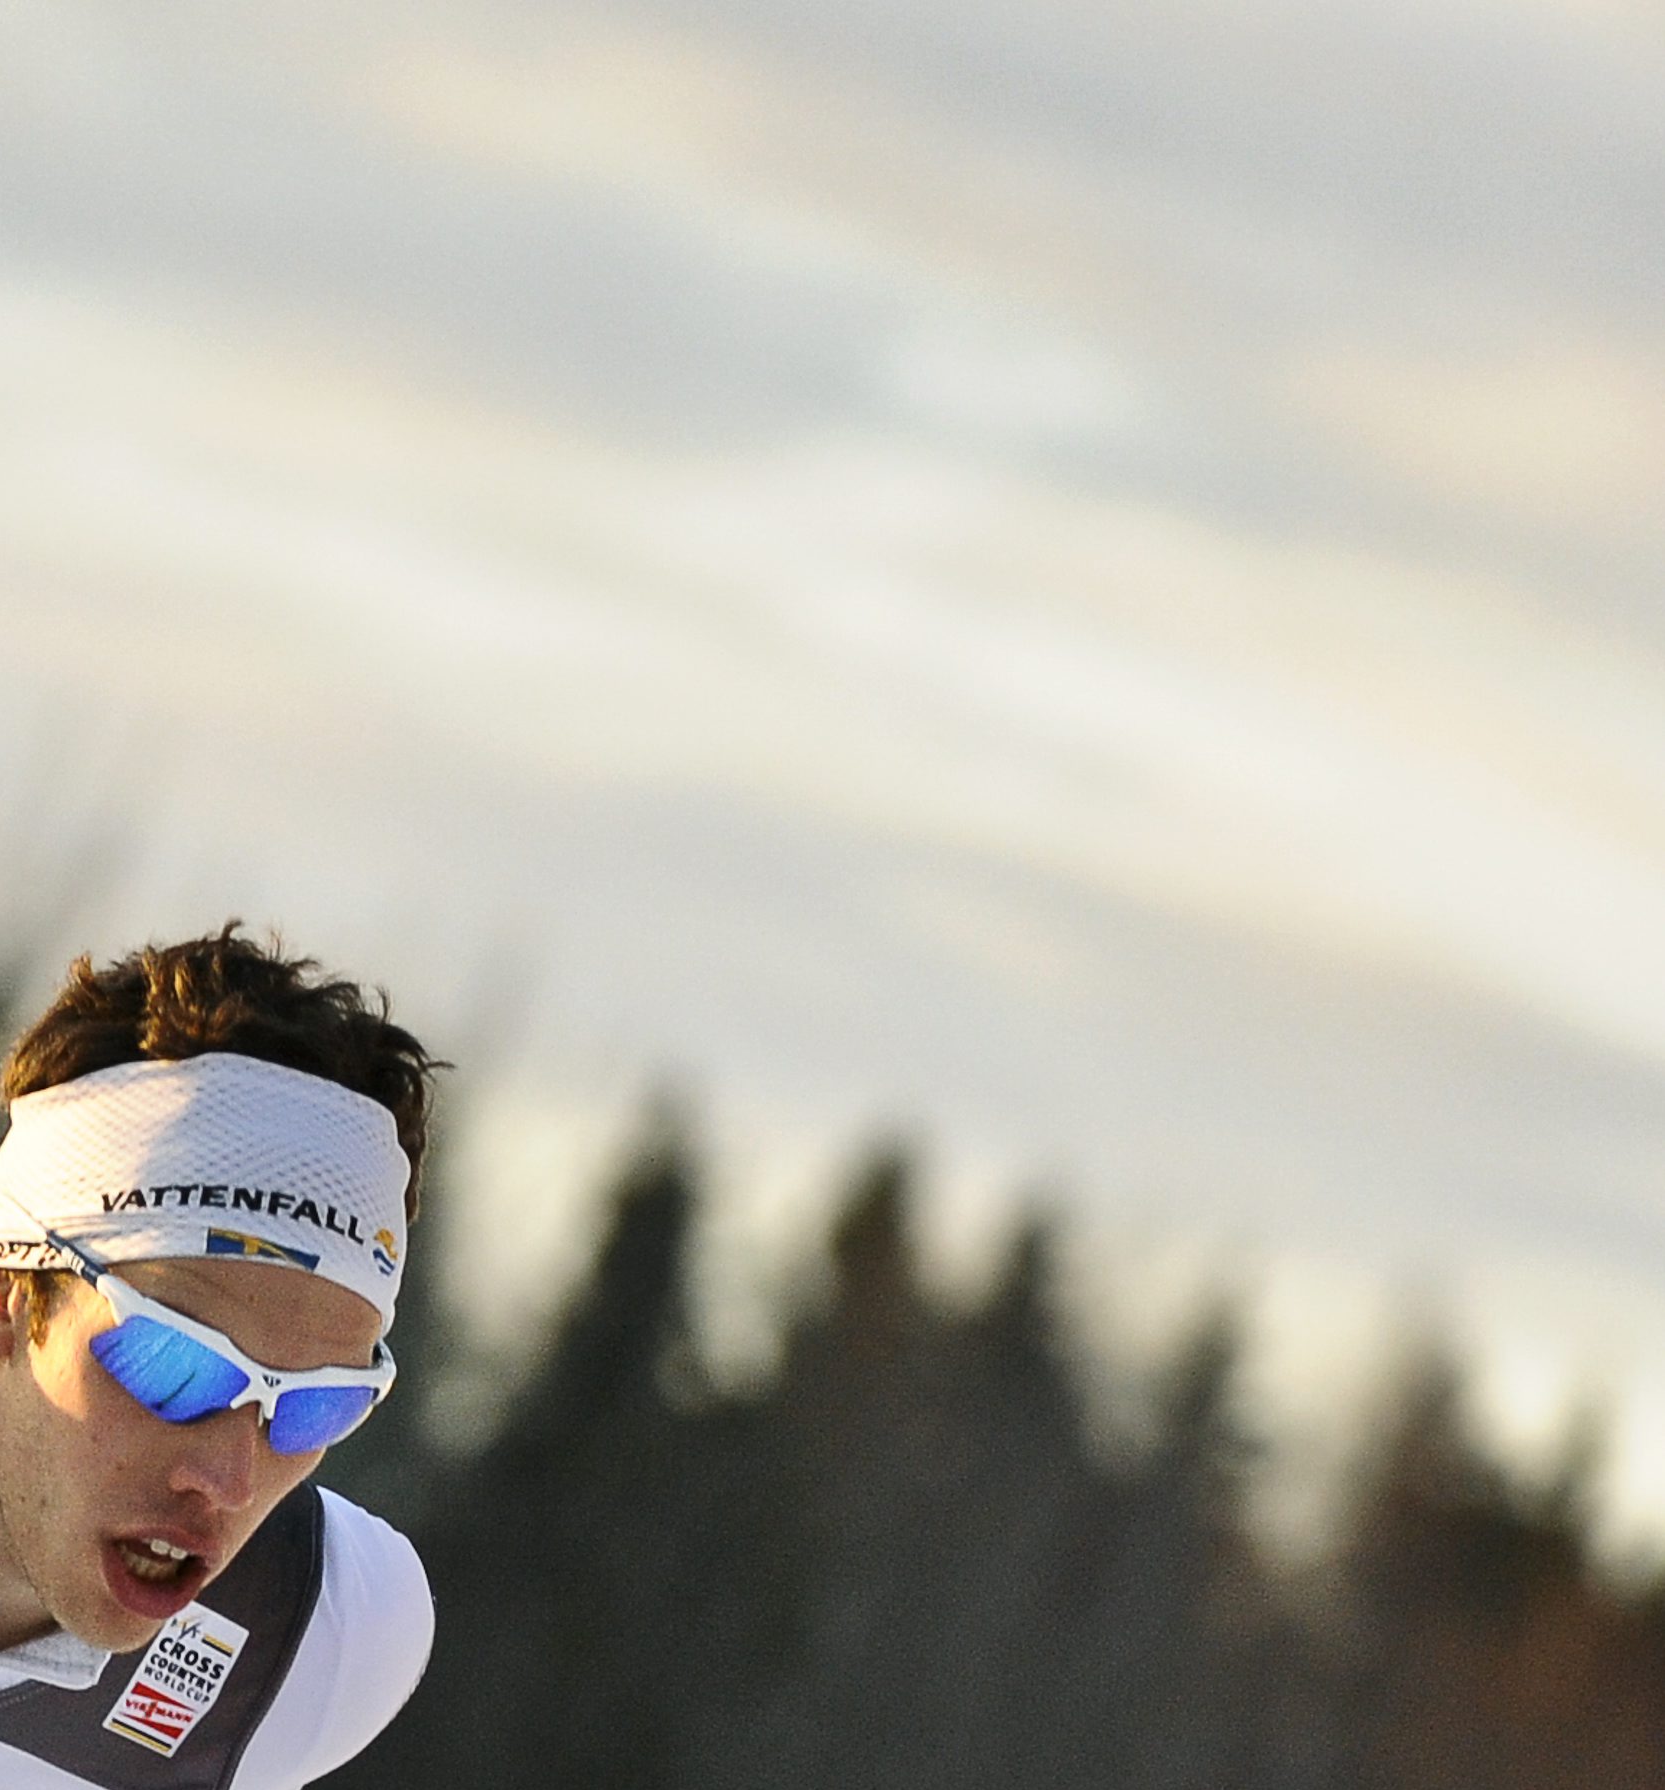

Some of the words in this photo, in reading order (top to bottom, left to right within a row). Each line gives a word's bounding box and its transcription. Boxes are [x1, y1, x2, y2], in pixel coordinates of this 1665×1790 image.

[101, 1182, 365, 1246] VATTENFALL
[149, 1653, 216, 1694] COUNTRY
[158, 1637, 226, 1680] CROSS
